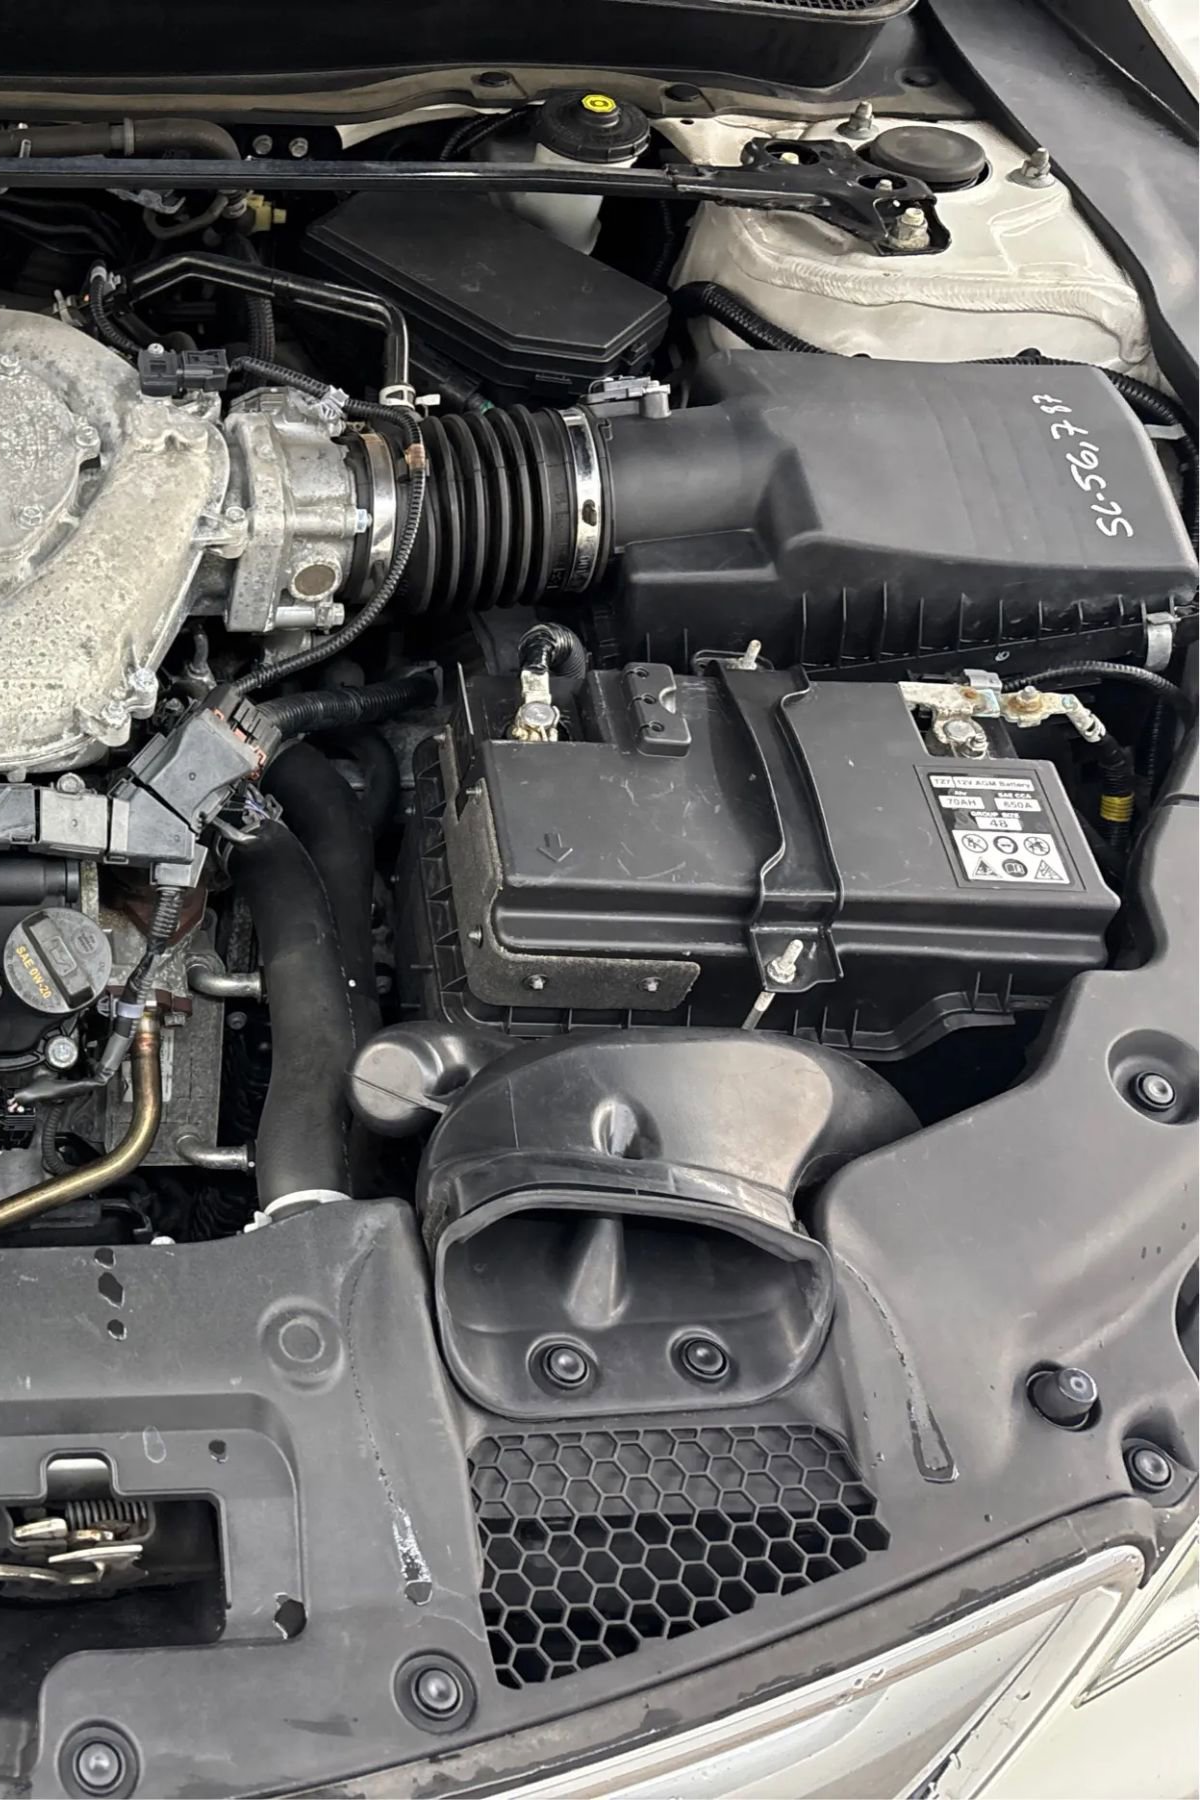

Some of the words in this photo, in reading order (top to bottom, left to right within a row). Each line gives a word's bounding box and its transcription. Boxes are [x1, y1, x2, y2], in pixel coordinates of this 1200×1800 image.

[999, 780, 1031, 789] Battery
[947, 798, 977, 807] 70AH
[989, 819, 1008, 828] 48
[16, 945, 35, 969] SAE
[29, 967, 52, 999] 0W-20
